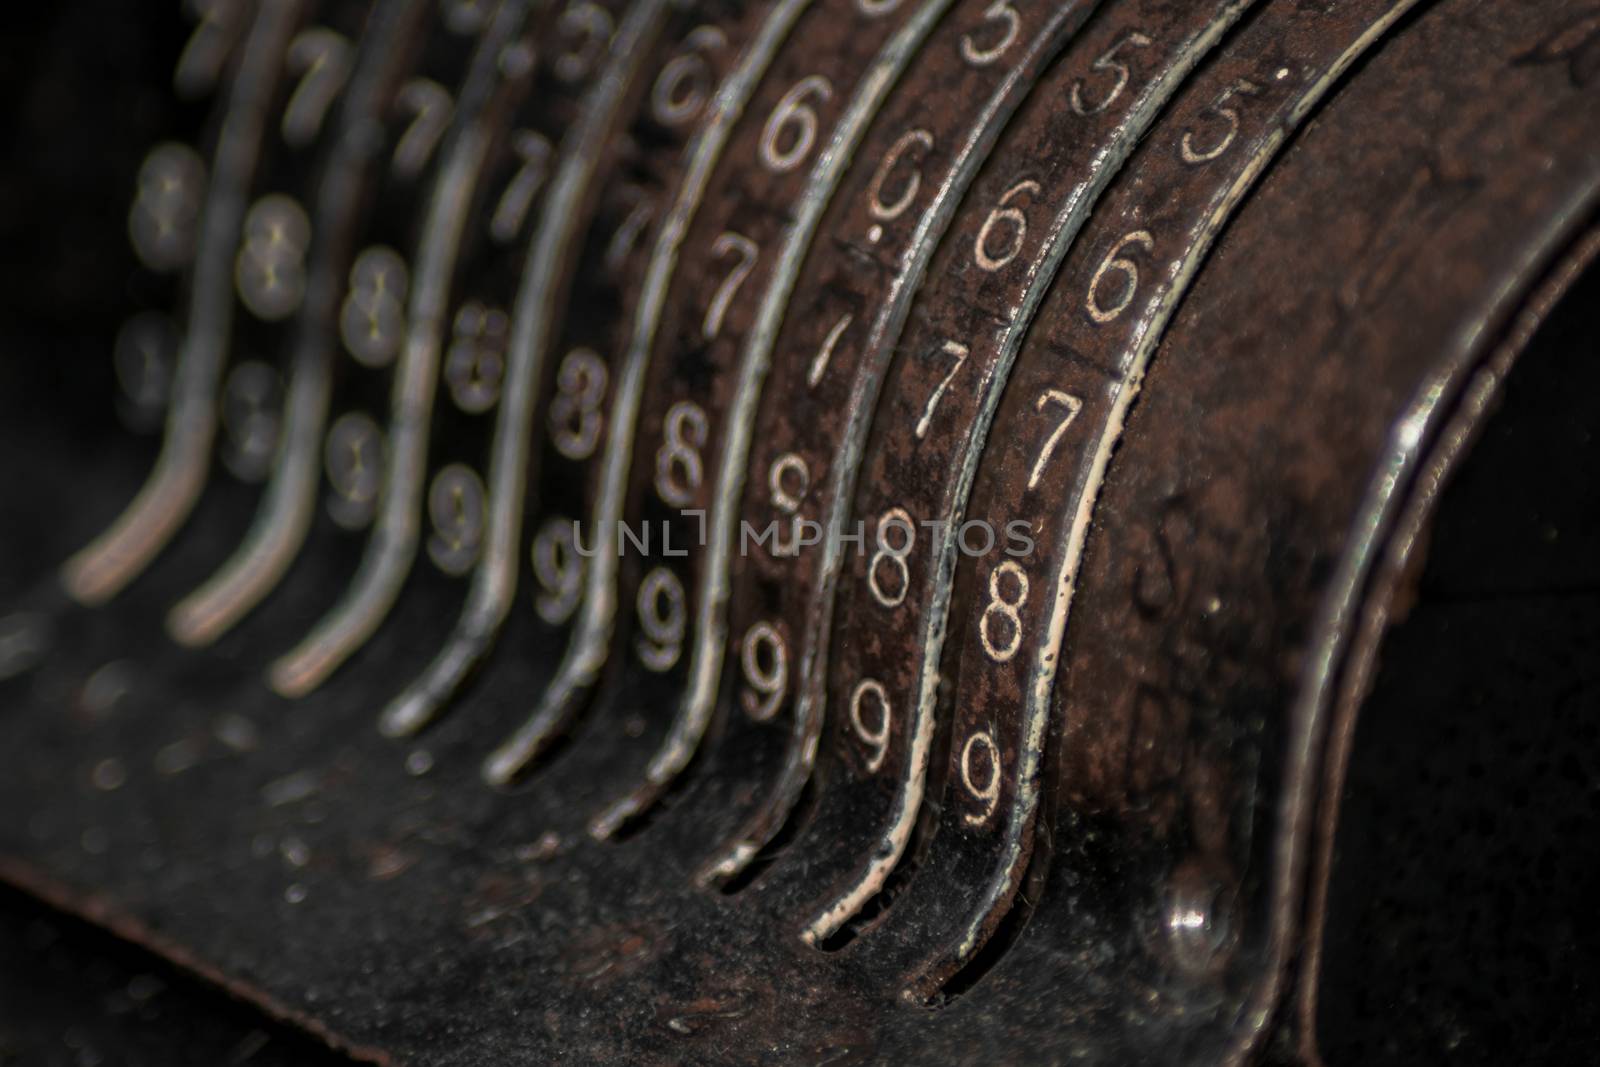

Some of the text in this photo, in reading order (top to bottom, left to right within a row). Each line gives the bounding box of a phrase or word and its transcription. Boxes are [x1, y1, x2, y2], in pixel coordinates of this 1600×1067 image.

[282, 27, 353, 150] 7
[759, 74, 833, 173] 6
[1071, 33, 1153, 117] 5
[1182, 80, 1262, 164] 5
[390, 77, 454, 182] 7
[489, 129, 551, 244] 7
[975, 180, 1042, 271] 6
[702, 230, 760, 340] 7
[1087, 231, 1155, 323] 6
[914, 341, 970, 438] 7
[1036, 389, 1083, 490] 7
[655, 400, 708, 508] 8
[428, 463, 487, 577] 9
[532, 516, 586, 625] 9
[868, 507, 917, 607] 8
[636, 566, 687, 672] 9
[979, 560, 1030, 662] 8
[742, 620, 789, 721] 9
[850, 678, 892, 774] 9
[960, 731, 1002, 825] 9
